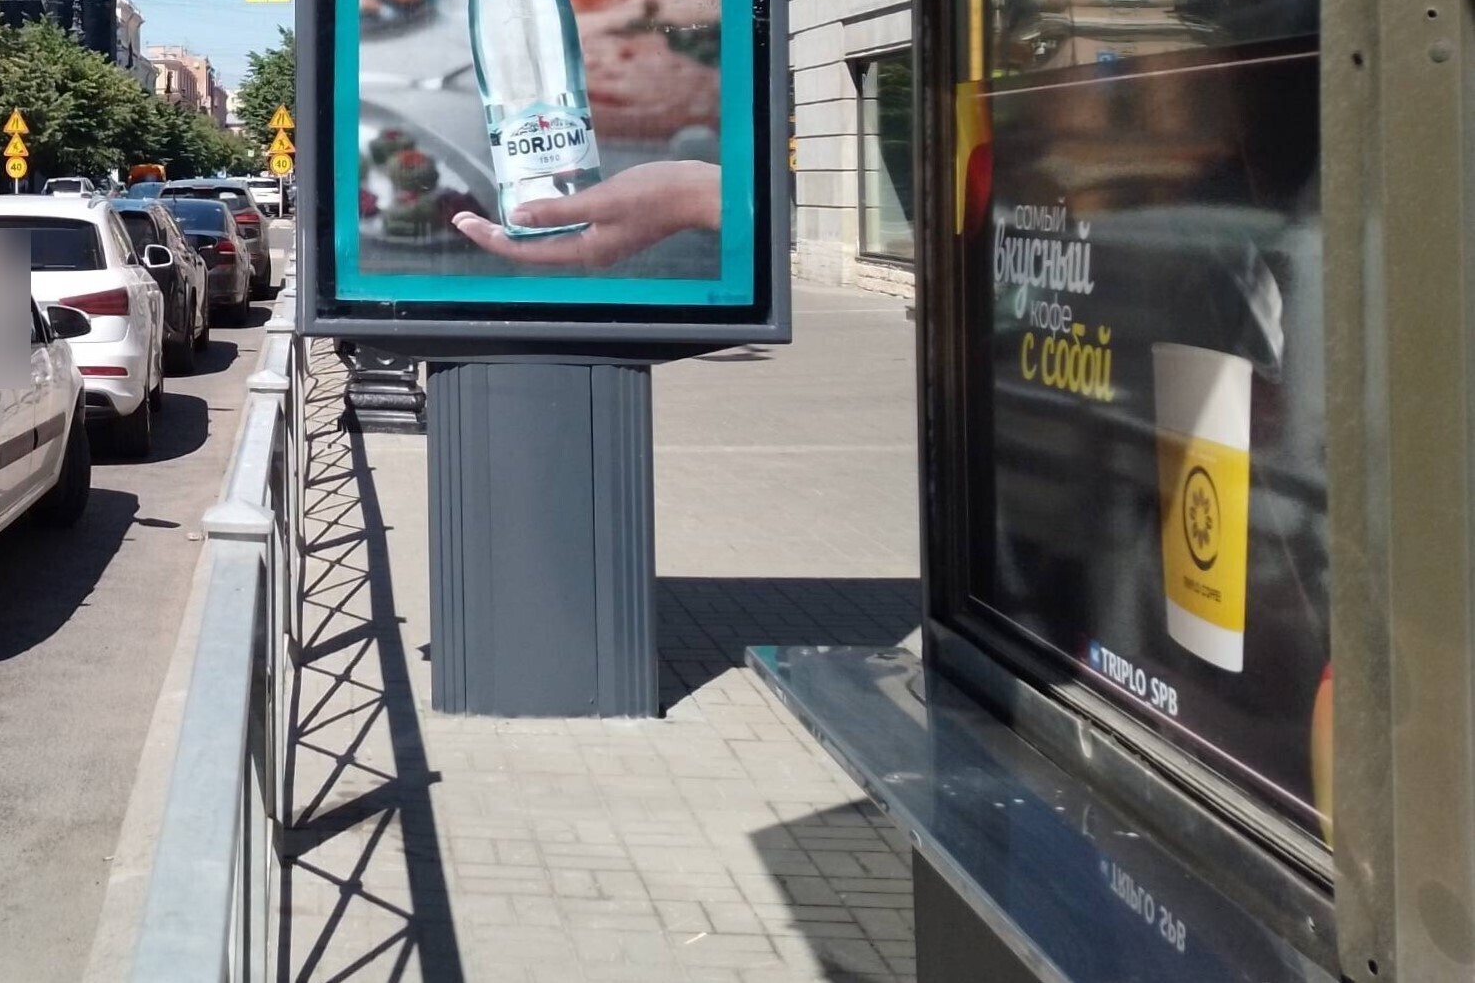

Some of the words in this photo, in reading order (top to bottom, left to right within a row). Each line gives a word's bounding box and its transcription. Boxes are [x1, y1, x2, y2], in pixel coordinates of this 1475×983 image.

[506, 128, 586, 157] BORJOMI
[539, 154, 561, 164] 1890
[10, 162, 22, 171] 40
[274, 159, 287, 168] 40
[1014, 197, 1067, 233] самый
[993, 217, 1095, 319] вкусный
[1030, 292, 1073, 341] кофе
[1021, 331, 1038, 380] с
[1041, 323, 1115, 403] собой
[1100, 646, 1147, 696] TRIPLO
[1150, 677, 1178, 716] SPB
